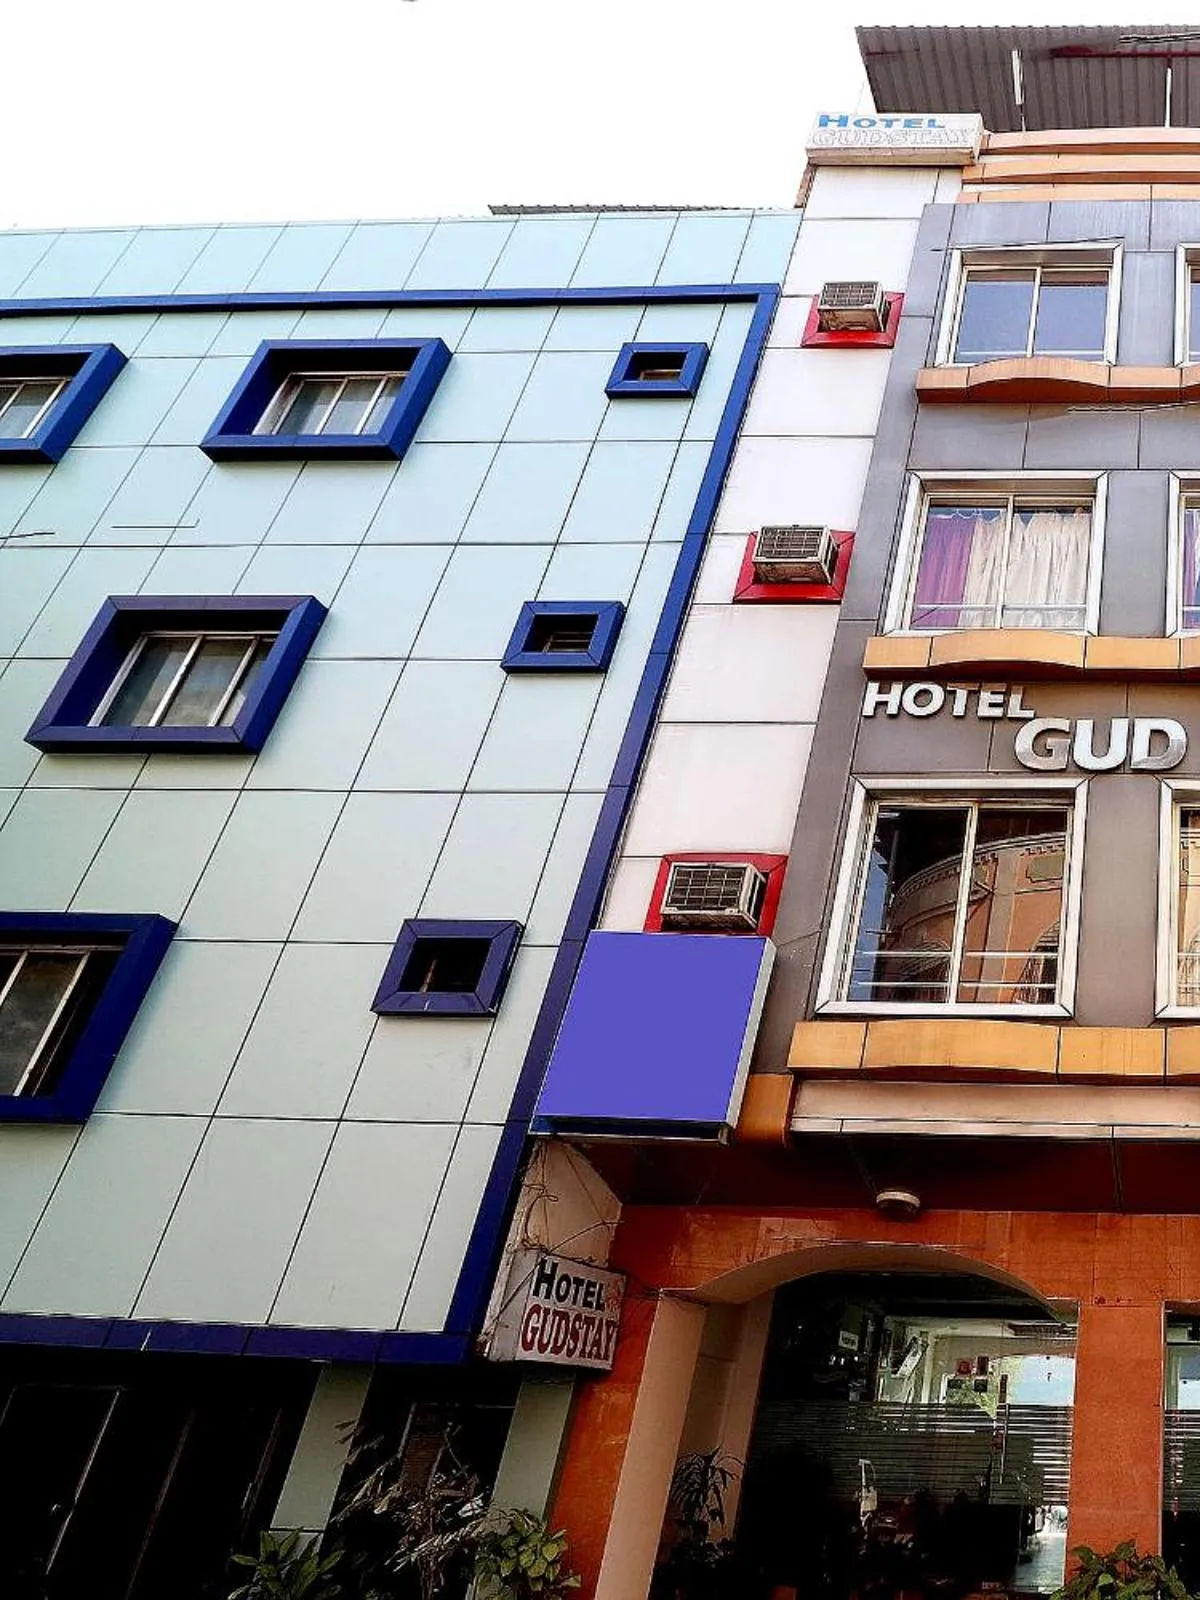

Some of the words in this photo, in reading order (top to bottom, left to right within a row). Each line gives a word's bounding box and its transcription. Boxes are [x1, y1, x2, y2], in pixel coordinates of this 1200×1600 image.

[818, 114, 945, 128] HOTEL
[861, 681, 1036, 720] HOTEL
[1013, 717, 1188, 772] GUD
[533, 1257, 605, 1311] HOTEL
[521, 1304, 617, 1360] GUDSTAY
